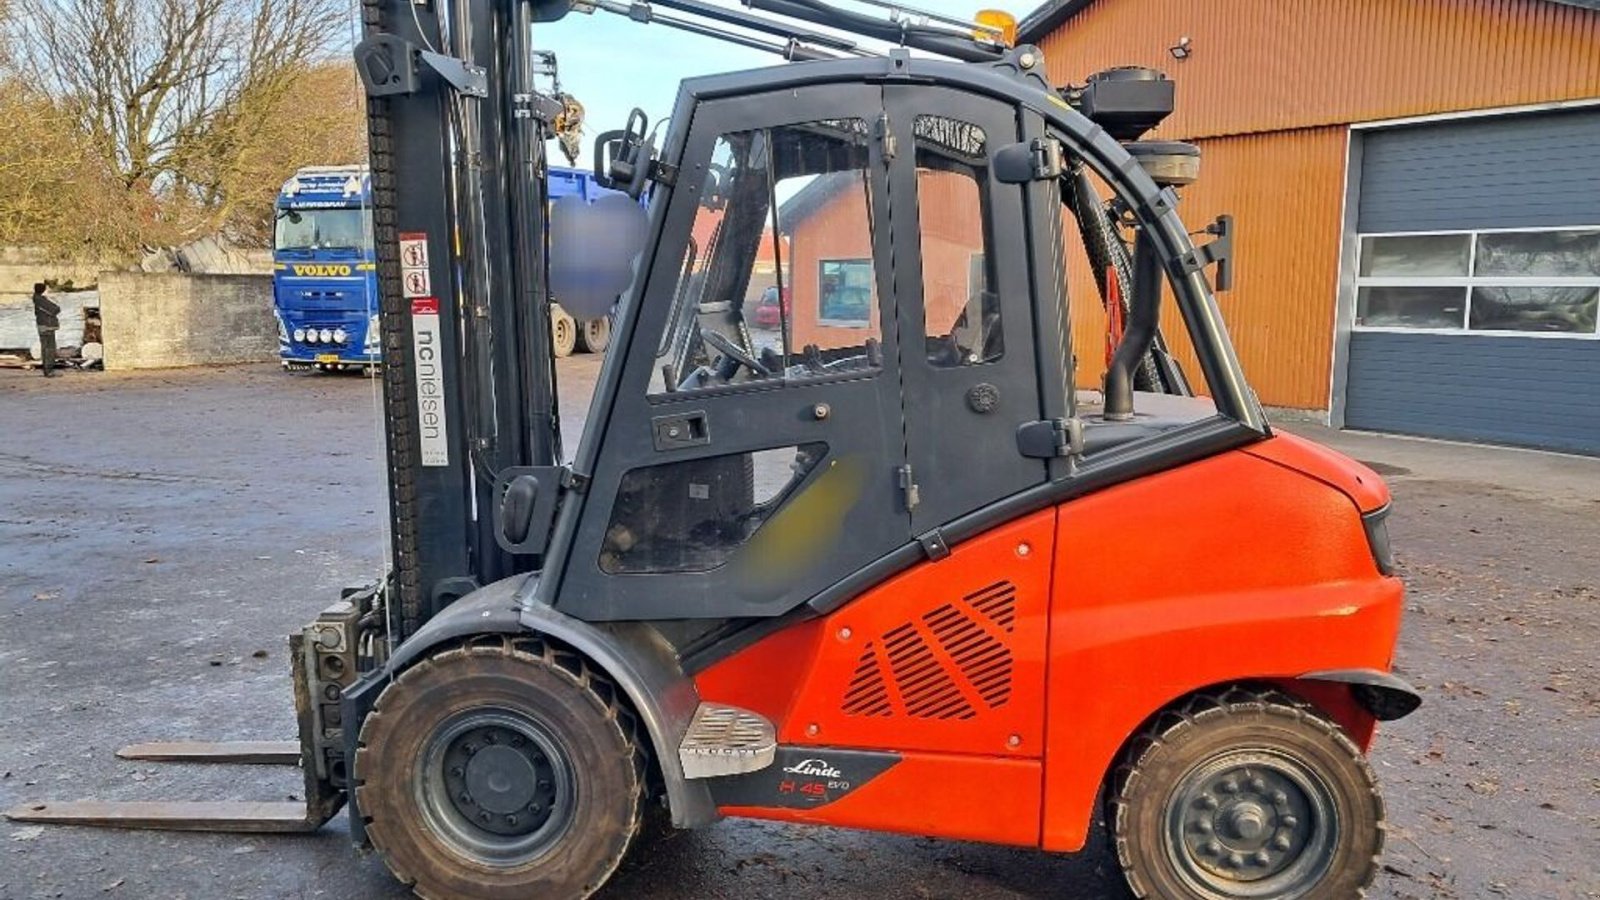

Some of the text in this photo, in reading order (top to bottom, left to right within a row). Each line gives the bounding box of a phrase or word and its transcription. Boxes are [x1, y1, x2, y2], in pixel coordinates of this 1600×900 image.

[292, 265, 351, 276] VOLVO
[783, 759, 841, 778] Linde
[779, 781, 795, 793] H
[801, 783, 825, 795] 45
